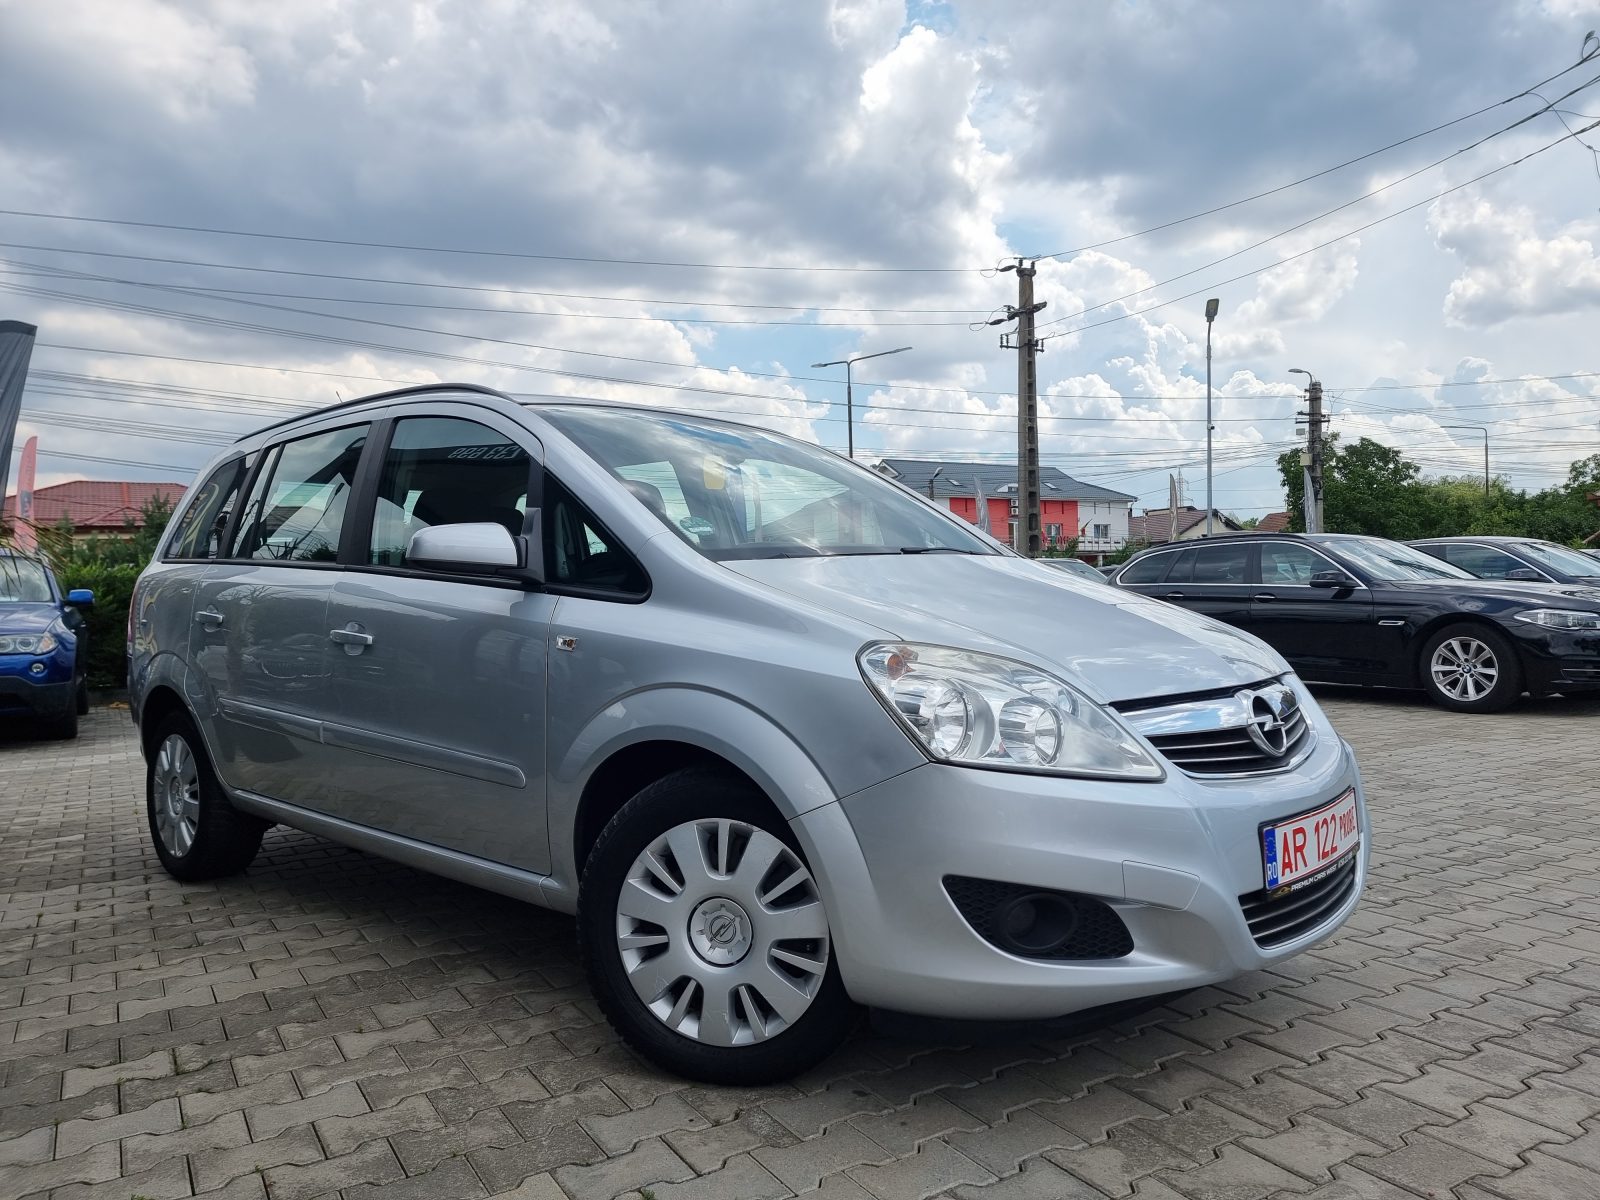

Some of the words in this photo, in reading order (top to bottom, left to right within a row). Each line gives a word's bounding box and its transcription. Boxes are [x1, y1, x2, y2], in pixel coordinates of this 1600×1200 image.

[1282, 827, 1308, 877] AR
[1314, 813, 1338, 862] 122
[1267, 863, 1278, 881] RO
[1291, 877, 1314, 891] PREMIUM
